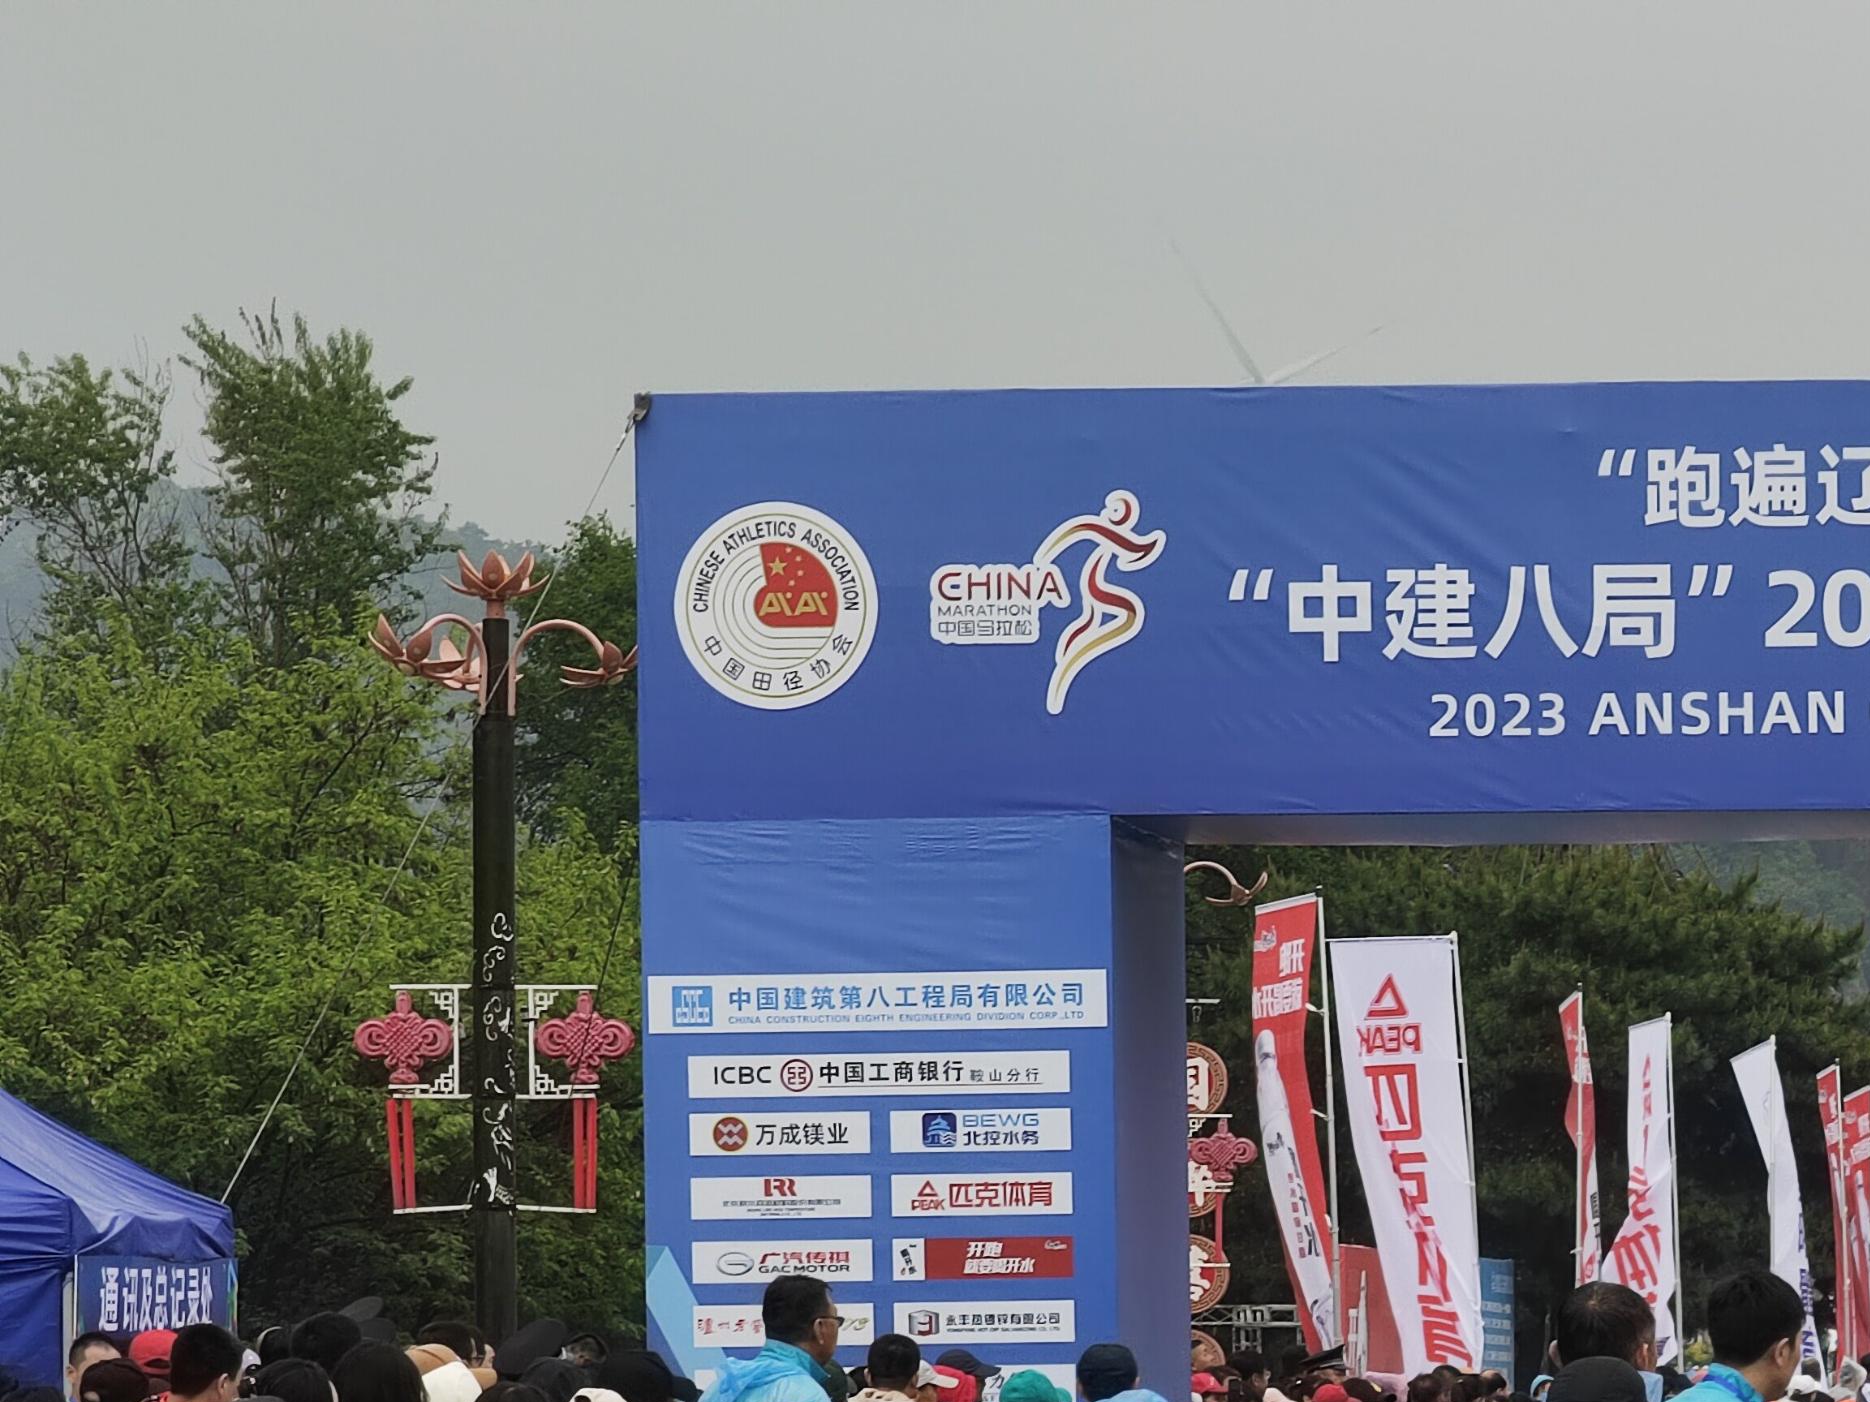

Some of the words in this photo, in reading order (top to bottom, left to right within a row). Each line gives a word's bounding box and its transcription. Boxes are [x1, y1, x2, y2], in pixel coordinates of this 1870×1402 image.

[692, 549, 725, 613] CHINESE
[722, 519, 797, 556] ATHLETICS
[799, 527, 860, 612] ASSOCIATION
[937, 570, 1063, 601] CHINA
[937, 604, 1032, 617] MARATHON
[1227, 561, 1735, 663] “中建八局”
[937, 620, 1032, 636] 中国马拉松
[703, 633, 853, 692] 中国田径协会
[1428, 692, 1567, 738] 2023
[1588, 690, 1846, 736] ANSHAN
[728, 982, 1084, 1012] 中国建筑第八工程局有限公司
[728, 1016, 761, 1025] CHINA
[766, 1015, 850, 1024] CONSTRUCTION
[855, 1014, 894, 1023] EIGHTH
[899, 1013, 972, 1022] ENGINEERING
[713, 1066, 772, 1085] ICBC
[818, 1060, 965, 1084] 中国工商银行
[970, 1067, 1041, 1083] 鞍山分行
[963, 1113, 1039, 1127] BEWG
[755, 1122, 849, 1146] 万成镁业
[963, 1130, 1039, 1146] 北控水务
[911, 1199, 945, 1211] PEAK
[949, 1181, 1053, 1208] 匹克体育
[758, 1265, 791, 1273] GAC
[792, 1264, 850, 1273] MOTOR
[759, 1251, 850, 1264] 广汽传祺
[98, 1265, 213, 1332] 通讯及总记录处
